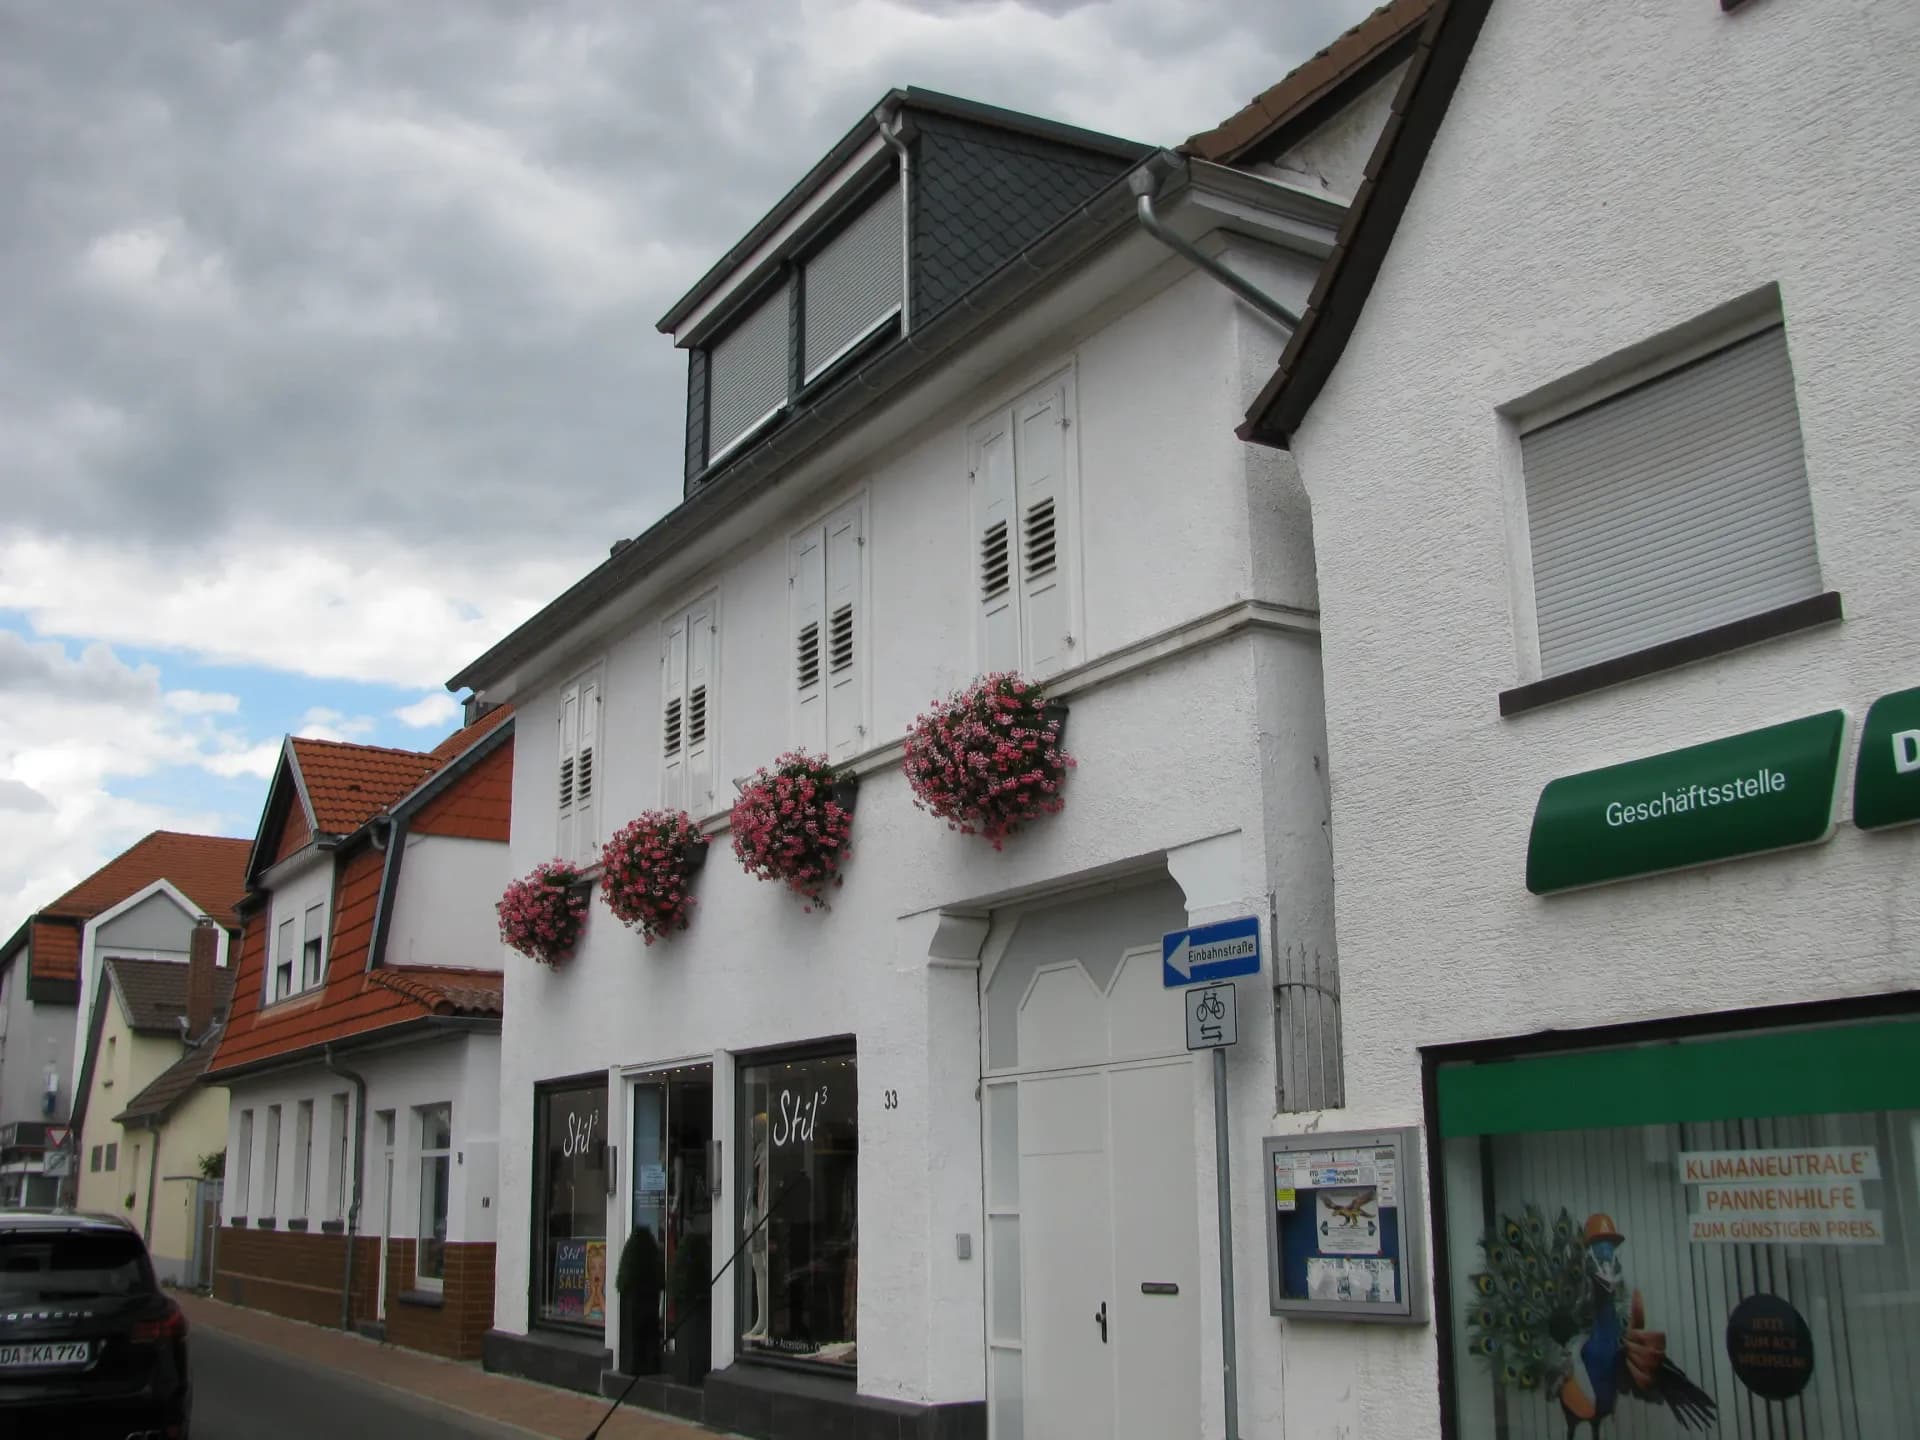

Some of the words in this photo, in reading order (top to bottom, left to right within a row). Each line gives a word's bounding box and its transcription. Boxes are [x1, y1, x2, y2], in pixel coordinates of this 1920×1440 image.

[1605, 768, 1786, 827] Geschäftsstelle
[1188, 941, 1254, 963] Einbahnstraße
[884, 1089, 898, 1110] 33
[1706, 1186, 1857, 1211] PANNENHILFE
[1692, 1221, 1726, 1239] ZUM
[1730, 1218, 1822, 1238] GÜNSTIGEN
[1826, 1220, 1881, 1238] PREIS.
[559, 1275, 583, 1289] SALE
[0, 1311, 93, 1321] ORSCHE
[1, 1348, 20, 1364] DA
[32, 1345, 53, 1361] KA
[57, 1344, 86, 1360] 776
